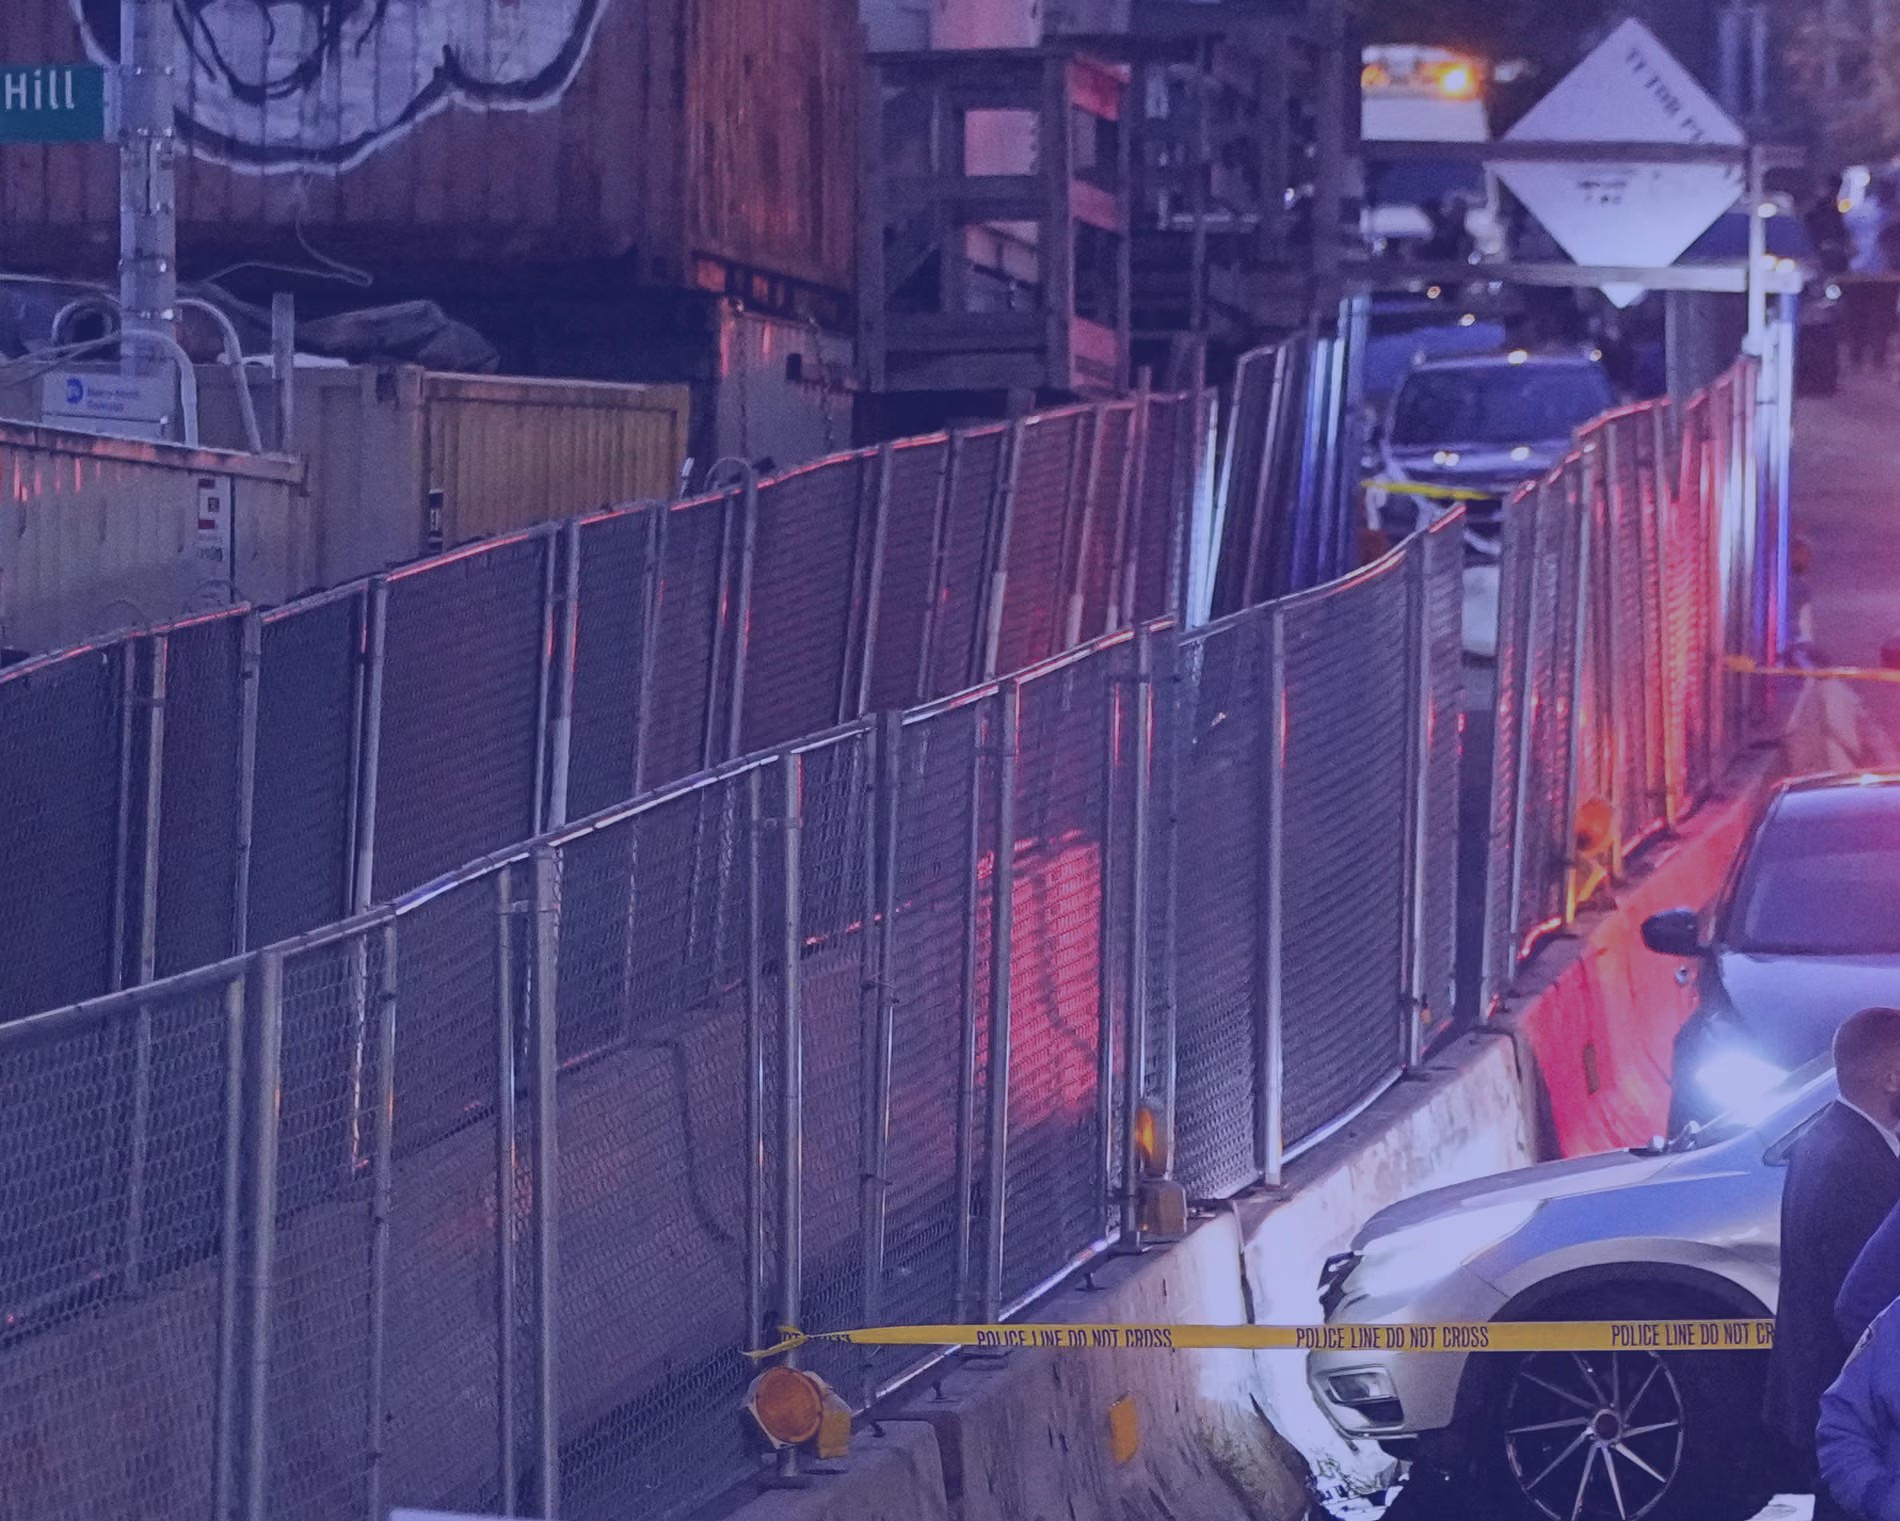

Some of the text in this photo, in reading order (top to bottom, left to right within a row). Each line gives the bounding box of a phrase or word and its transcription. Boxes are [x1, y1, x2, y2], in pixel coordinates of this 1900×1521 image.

[4, 68, 76, 111] Hill
[976, 1329, 1026, 1346] POLICE
[1068, 1329, 1087, 1347] DO
[1092, 1328, 1121, 1348] NOT
[1125, 1328, 1174, 1348] CROSS
[1296, 1326, 1490, 1349] POLICE LINE DO NOT CROSS
[1612, 1325, 1660, 1347] POLICE
[1665, 1323, 1695, 1346] LINE
[1700, 1323, 1719, 1345] DO
[1723, 1322, 1750, 1345] NOT
